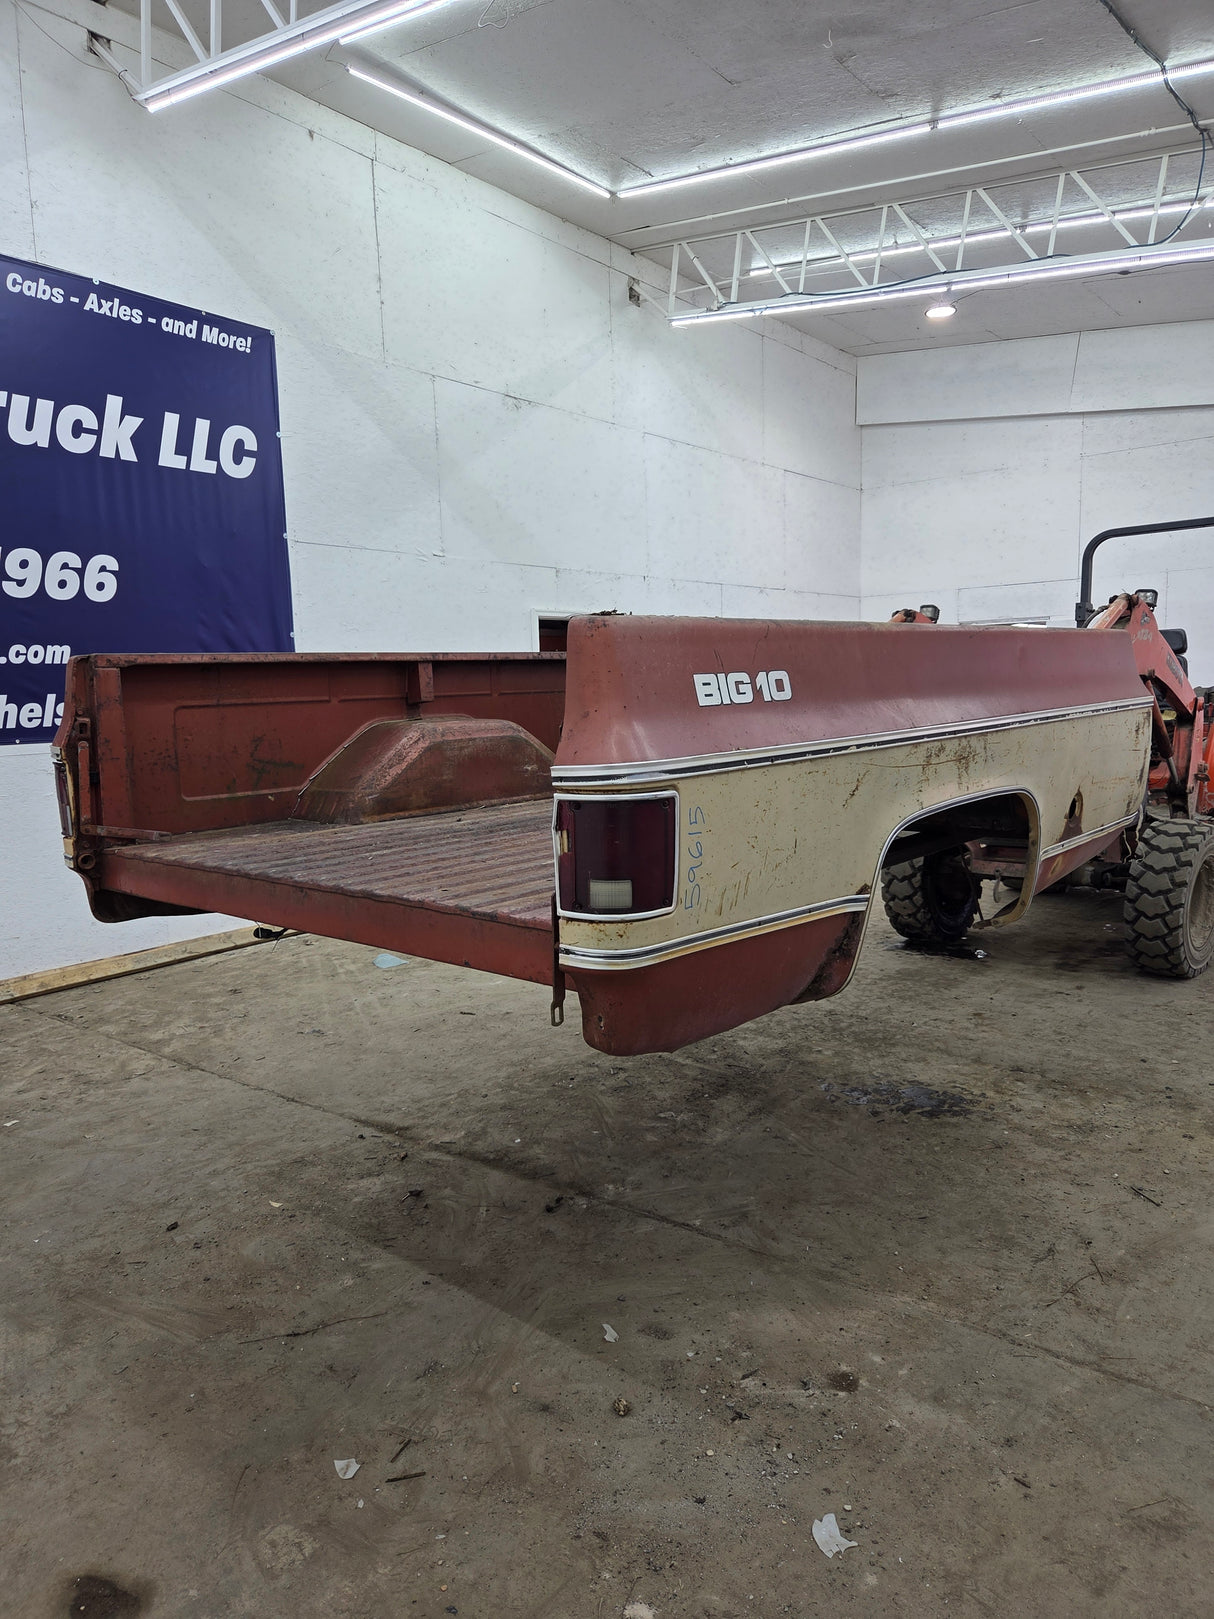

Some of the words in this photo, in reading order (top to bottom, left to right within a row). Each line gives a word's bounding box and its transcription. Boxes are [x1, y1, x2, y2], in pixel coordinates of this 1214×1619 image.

[6, 272, 65, 304] Cabs
[83, 292, 143, 324] Axles
[161, 316, 198, 339] and
[201, 324, 252, 354] More!
[0, 390, 145, 463] uck
[158, 411, 258, 479] LLC
[0, 546, 119, 603] 966
[0, 644, 71, 665] .com
[693, 671, 754, 707] BIG
[755, 669, 792, 702] 10
[684, 805, 706, 911] 59615
